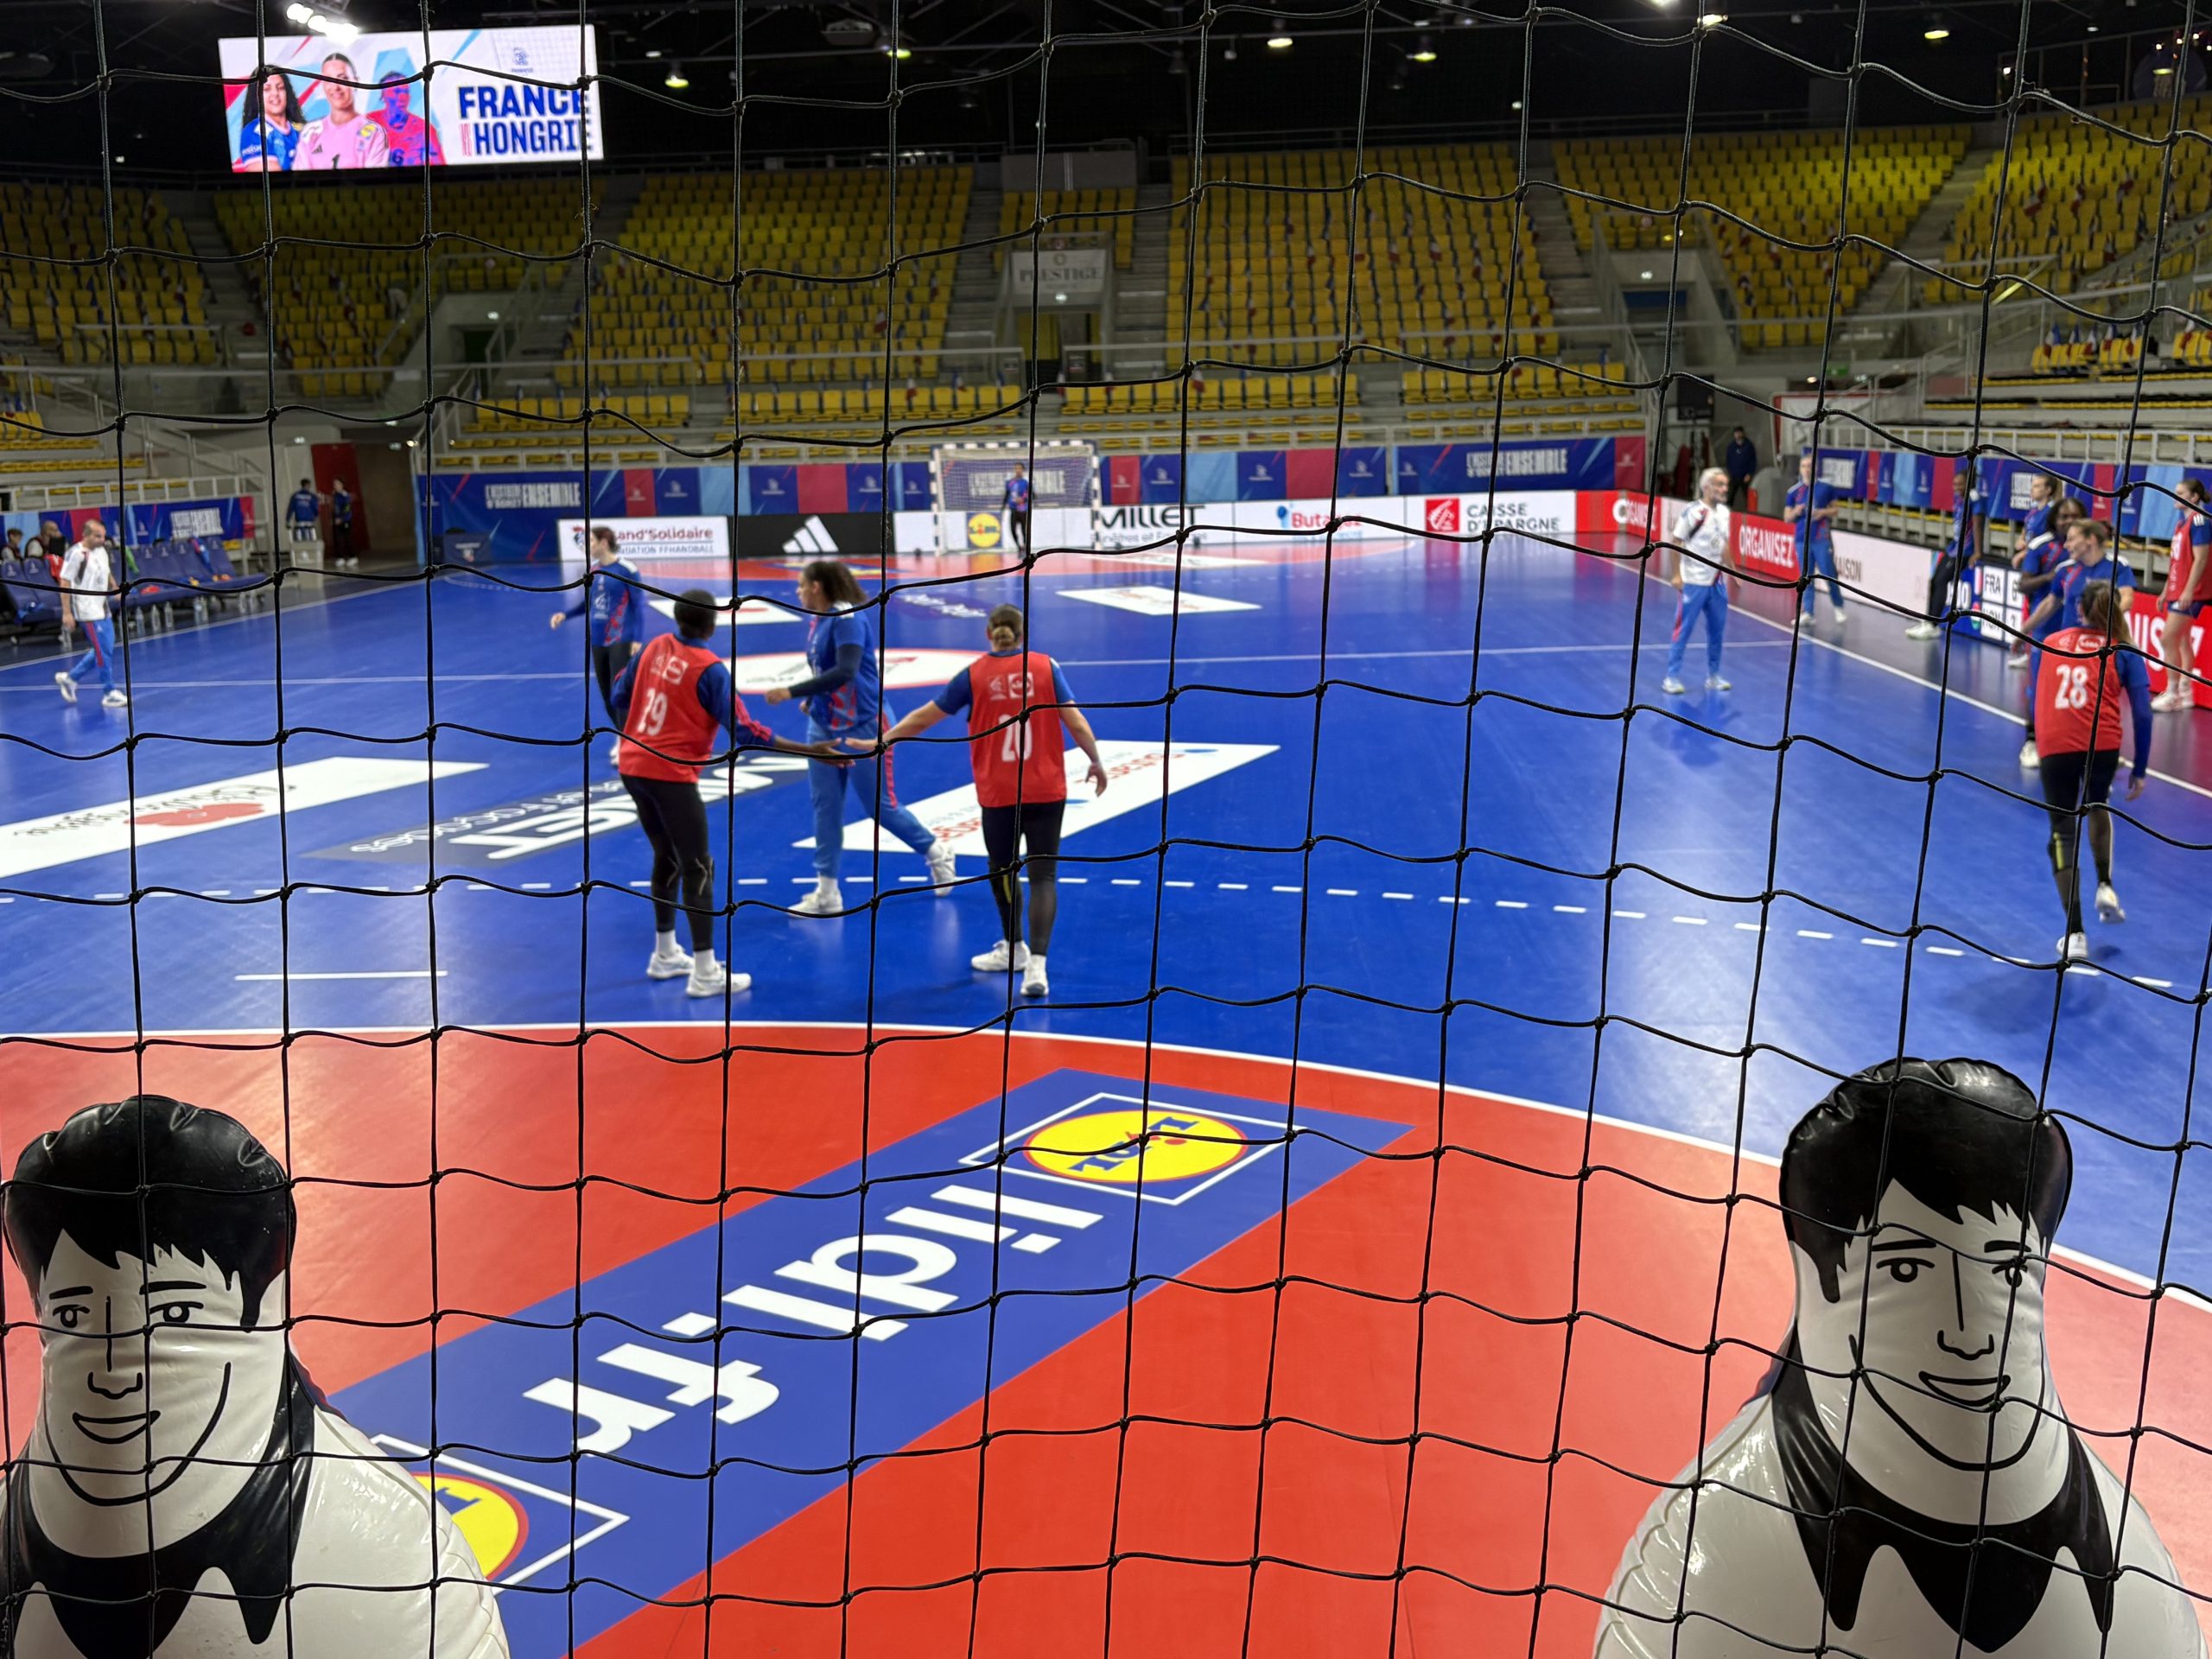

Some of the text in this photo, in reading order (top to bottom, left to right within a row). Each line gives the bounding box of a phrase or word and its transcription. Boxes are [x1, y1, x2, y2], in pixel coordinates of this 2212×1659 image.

[459, 85, 591, 118] FRANCE
[474, 118, 592, 155] HONGRIE
[618, 524, 714, 541] and'Solidaire
[1739, 524, 1795, 569] ORGANISEZ
[1985, 573, 2001, 596] FRA
[2055, 664, 2088, 709] 28
[999, 714, 1033, 761] 20
[522, 1185, 1103, 1457] lidl.fr
